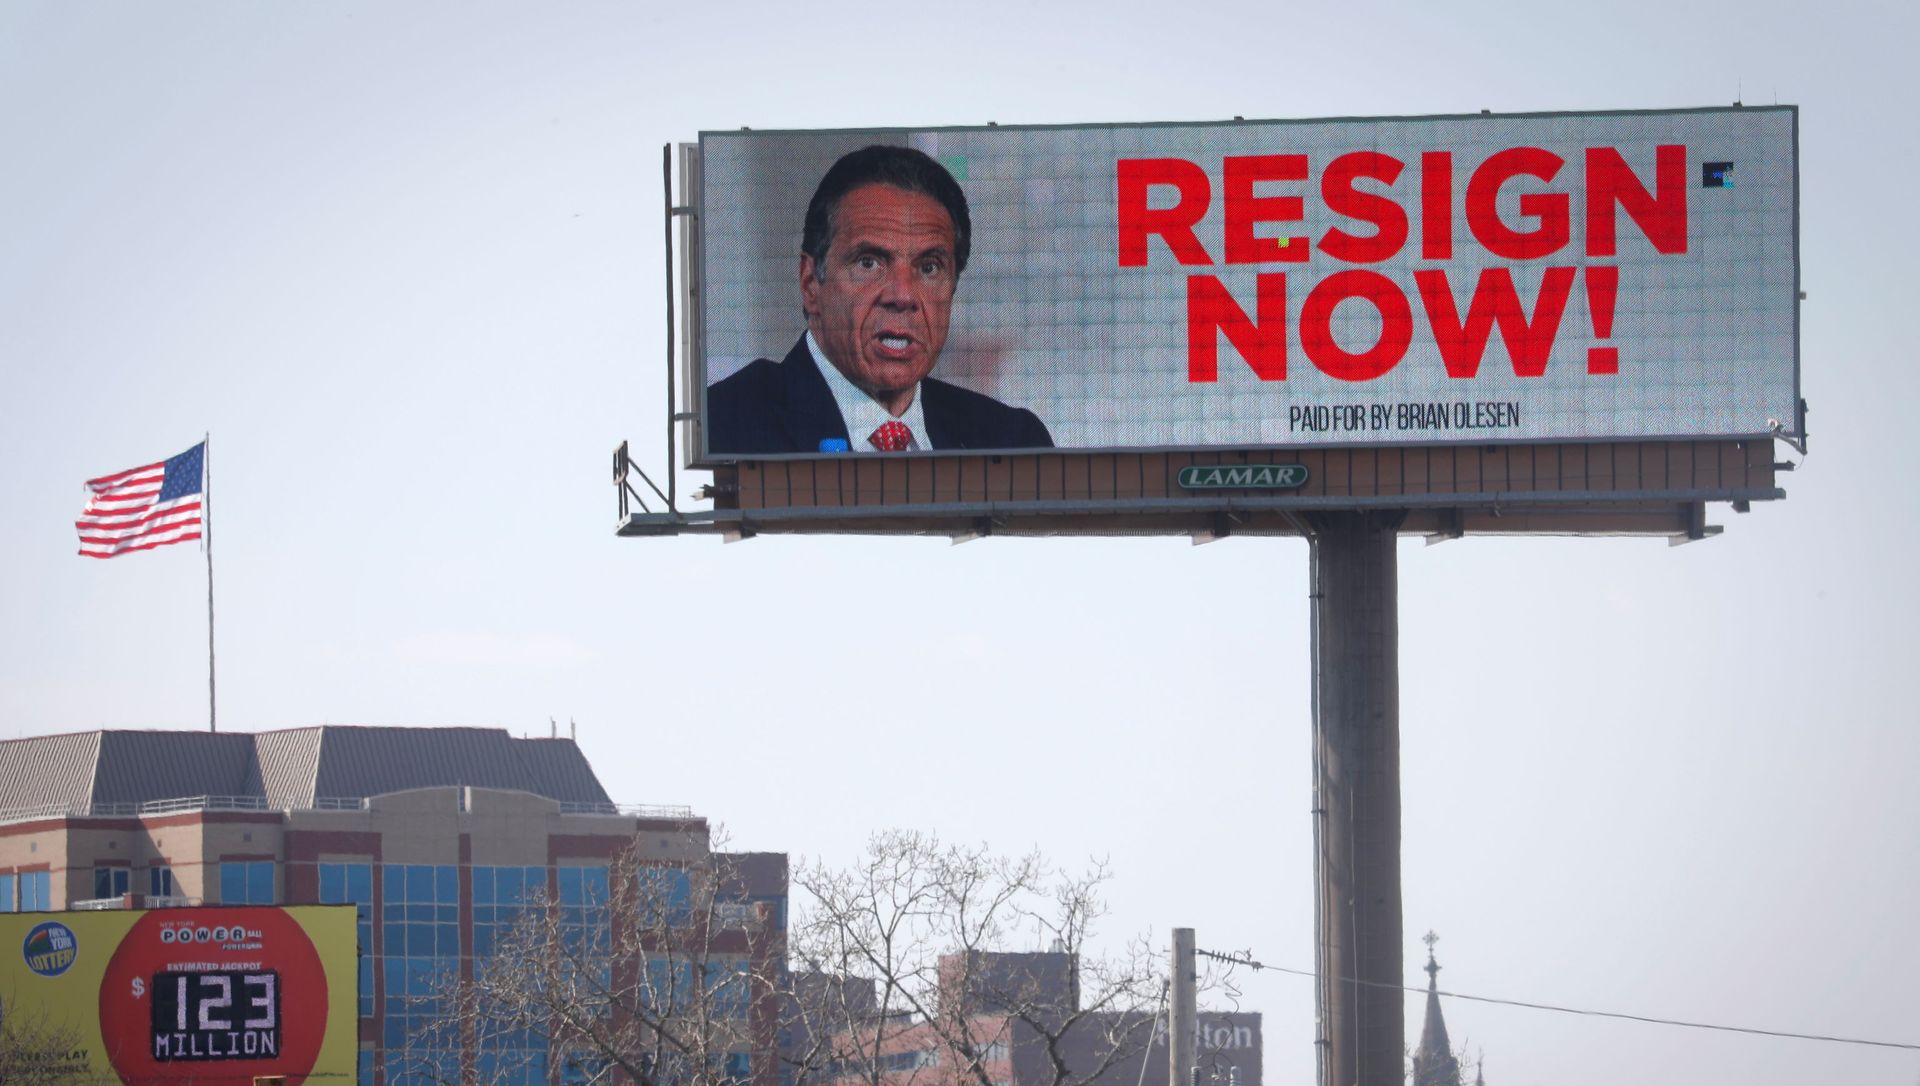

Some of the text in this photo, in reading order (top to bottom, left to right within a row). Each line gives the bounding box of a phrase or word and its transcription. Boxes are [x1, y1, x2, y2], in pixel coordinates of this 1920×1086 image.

[1117, 144, 1689, 267] RESIGN
[1187, 265, 1620, 383] NOW!
[1289, 401, 1520, 432] PAID FOR BY BRIAN OLESEN
[1188, 467, 1294, 486] LAMAR
[48, 927, 66, 938] NEW
[50, 936, 72, 951] YORK
[29, 948, 74, 970] LOTTERY
[167, 961, 262, 972] ESTIMATED JACKPOT
[176, 974, 275, 1030] 123
[155, 1030, 277, 1057] MILLION
